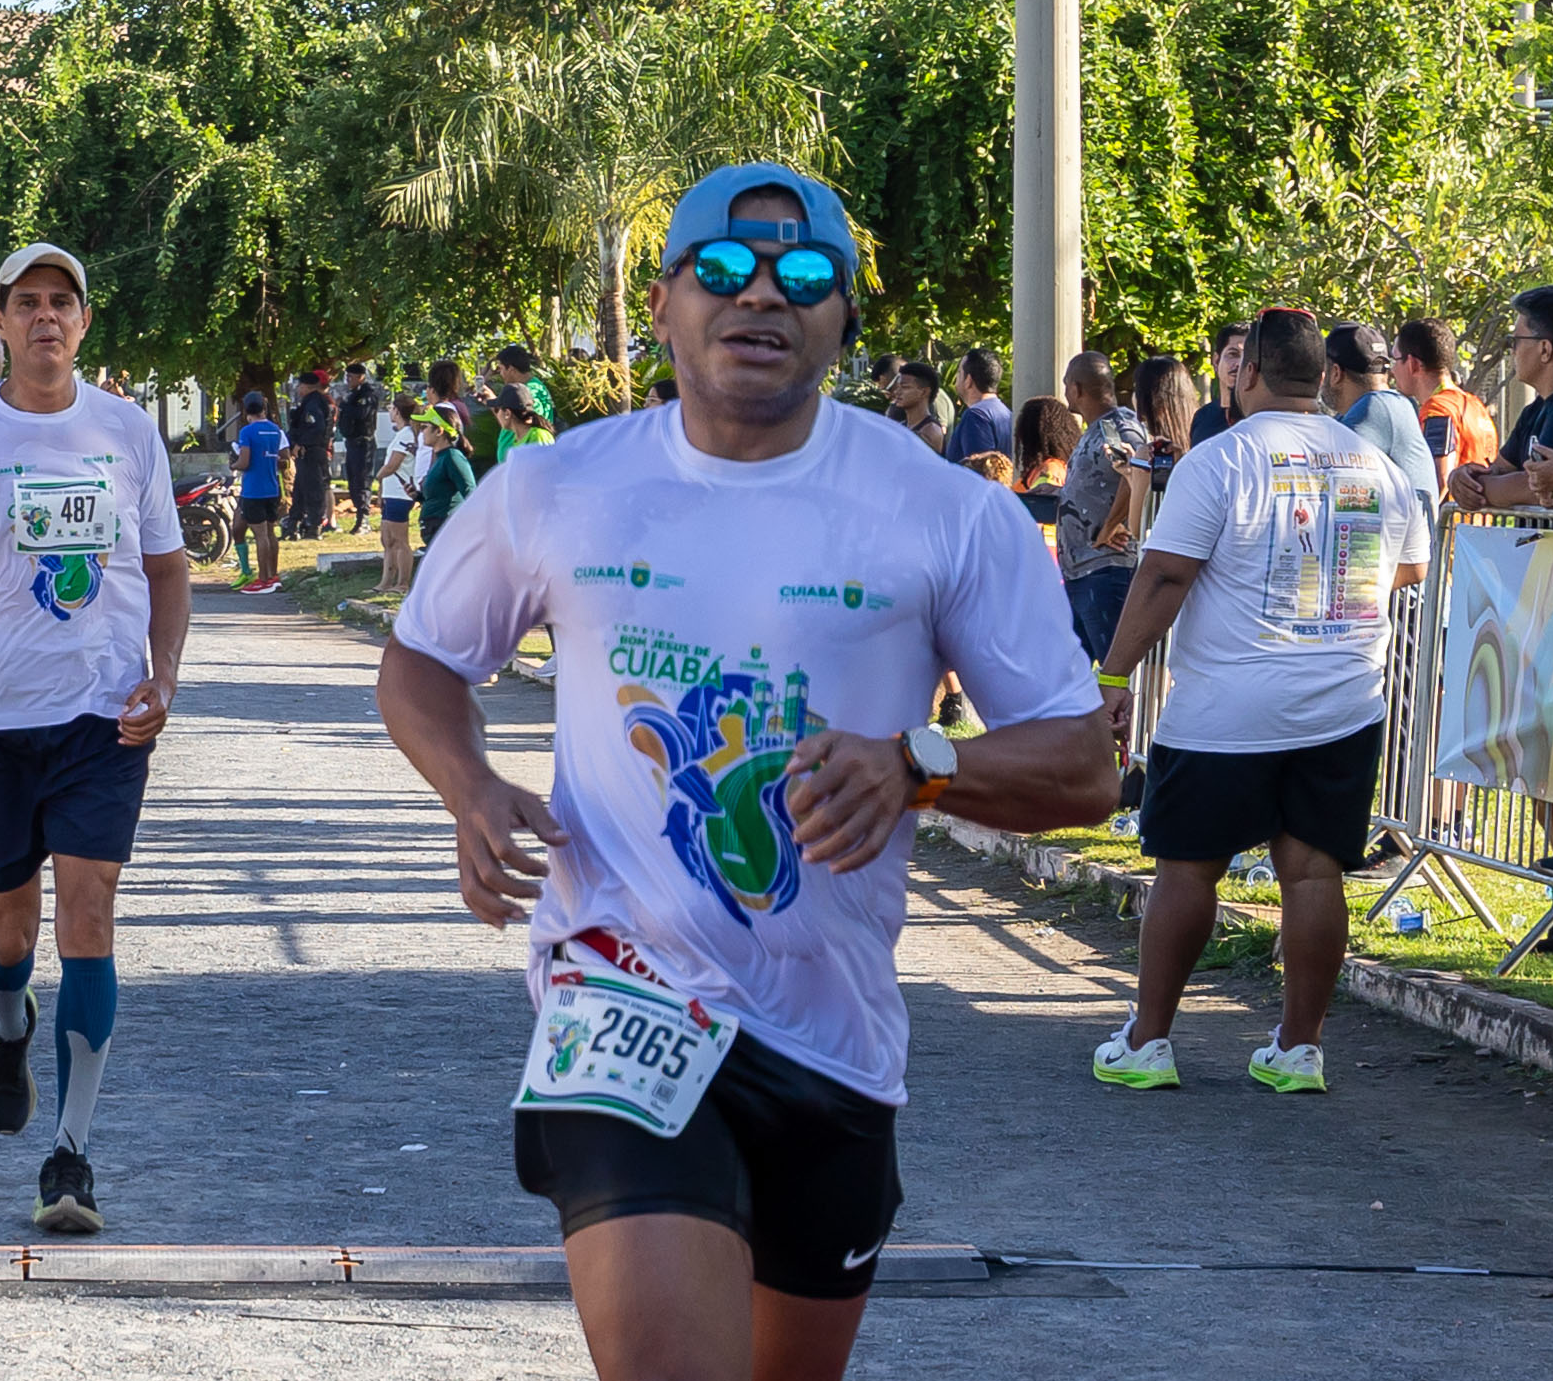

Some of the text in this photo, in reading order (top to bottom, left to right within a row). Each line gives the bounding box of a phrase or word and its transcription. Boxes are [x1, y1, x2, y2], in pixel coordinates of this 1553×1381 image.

[60, 495, 96, 523] 487
[619, 634, 711, 657] BOM JESUS DE
[609, 646, 725, 690] CUIABÁ
[615, 941, 660, 984] YO
[558, 989, 578, 1007] 10K
[590, 1006, 699, 1080] 2965
